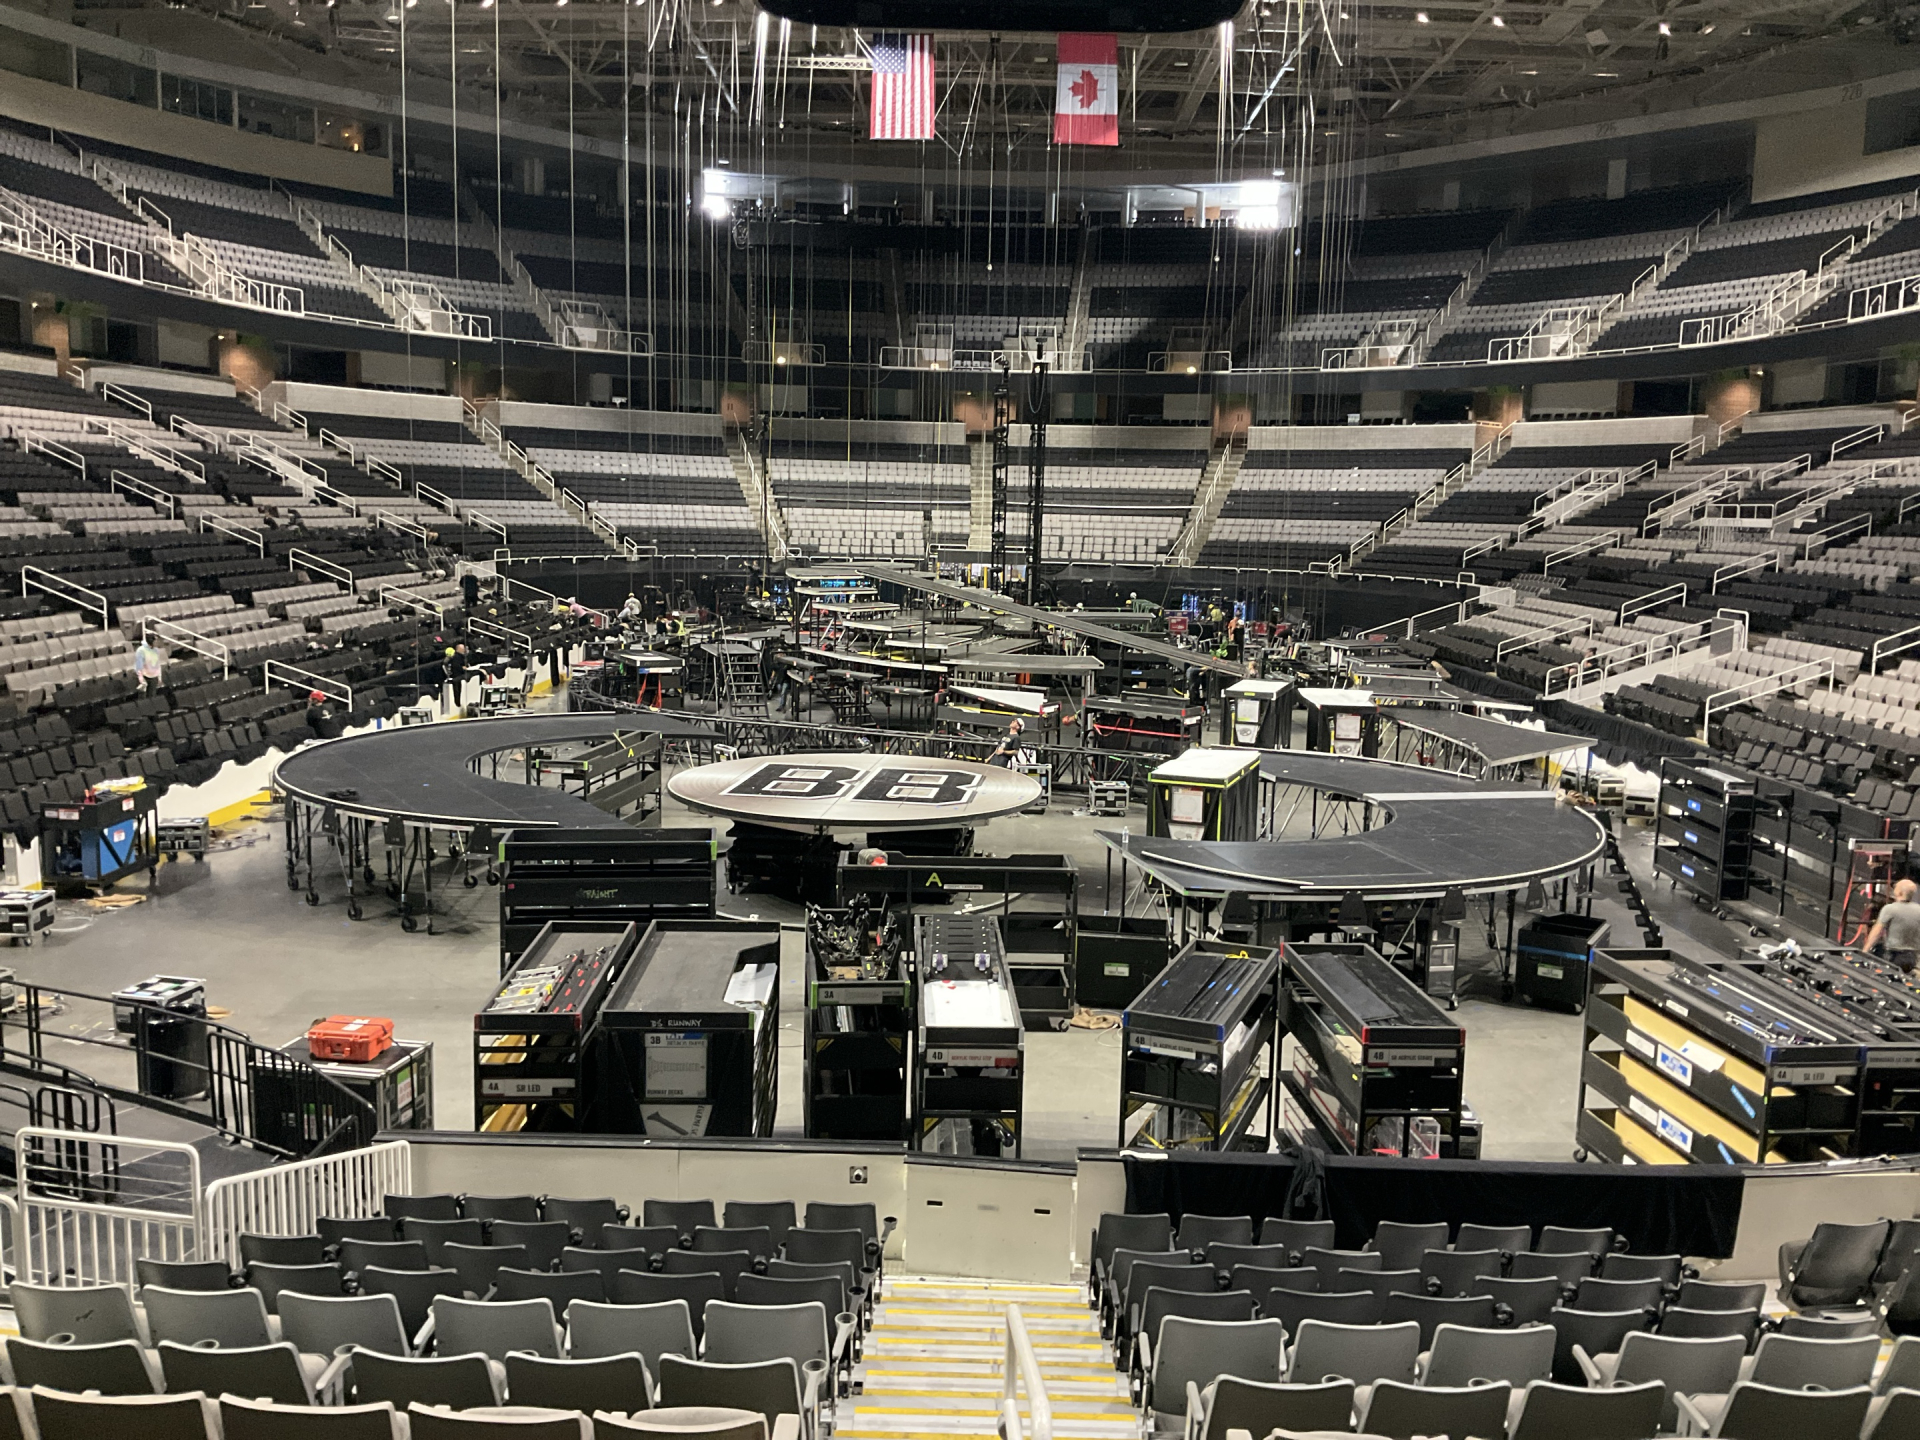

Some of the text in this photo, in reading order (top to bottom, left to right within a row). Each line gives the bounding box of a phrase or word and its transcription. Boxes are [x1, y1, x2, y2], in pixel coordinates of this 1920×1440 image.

[925, 872, 942, 887] A
[824, 990, 834, 999] 3A
[667, 1019, 702, 1027] RUNWAY
[650, 1036, 661, 1045] 3B
[1134, 1036, 1146, 1045] 4B
[932, 1051, 943, 1061] 4D
[1373, 1052, 1384, 1060] 4B
[1777, 1070, 1787, 1079] 4A
[1812, 1072, 1825, 1081] LED
[488, 1082, 499, 1091] 4A
[516, 1084, 541, 1093] SR LED
